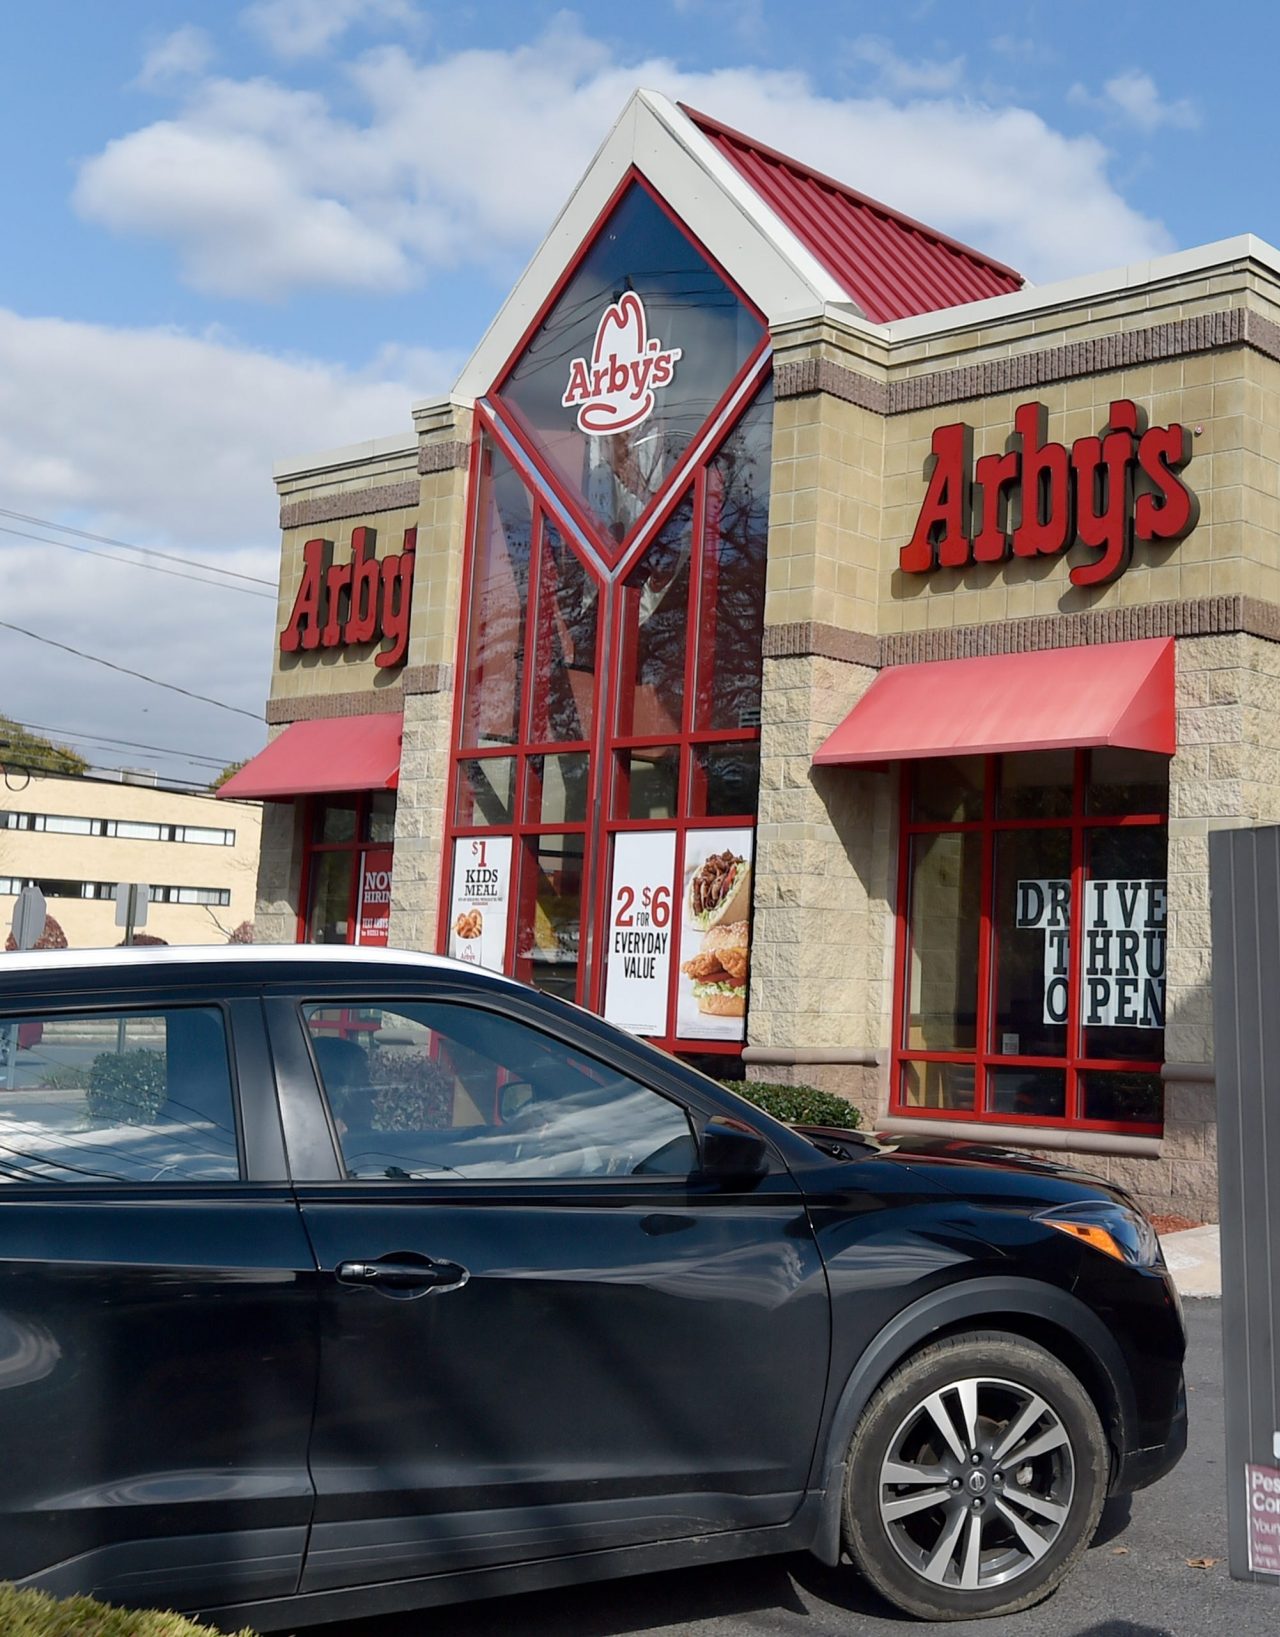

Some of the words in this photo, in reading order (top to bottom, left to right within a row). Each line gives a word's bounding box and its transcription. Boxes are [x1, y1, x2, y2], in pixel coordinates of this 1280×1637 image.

[564, 342, 672, 403] Arby's
[898, 399, 1199, 586] Arby's
[471, 840, 487, 868] $1
[464, 884, 498, 896] MEAL
[465, 868, 499, 884] KIDS
[615, 885, 635, 928] 2
[636, 911, 650, 927] FOR
[1017, 881, 1168, 928] DRIVE
[614, 931, 669, 955] EVERYDAY
[1049, 929, 1167, 978] THRU
[624, 956, 656, 980] VALUE
[1046, 977, 1167, 1027] OPEN
